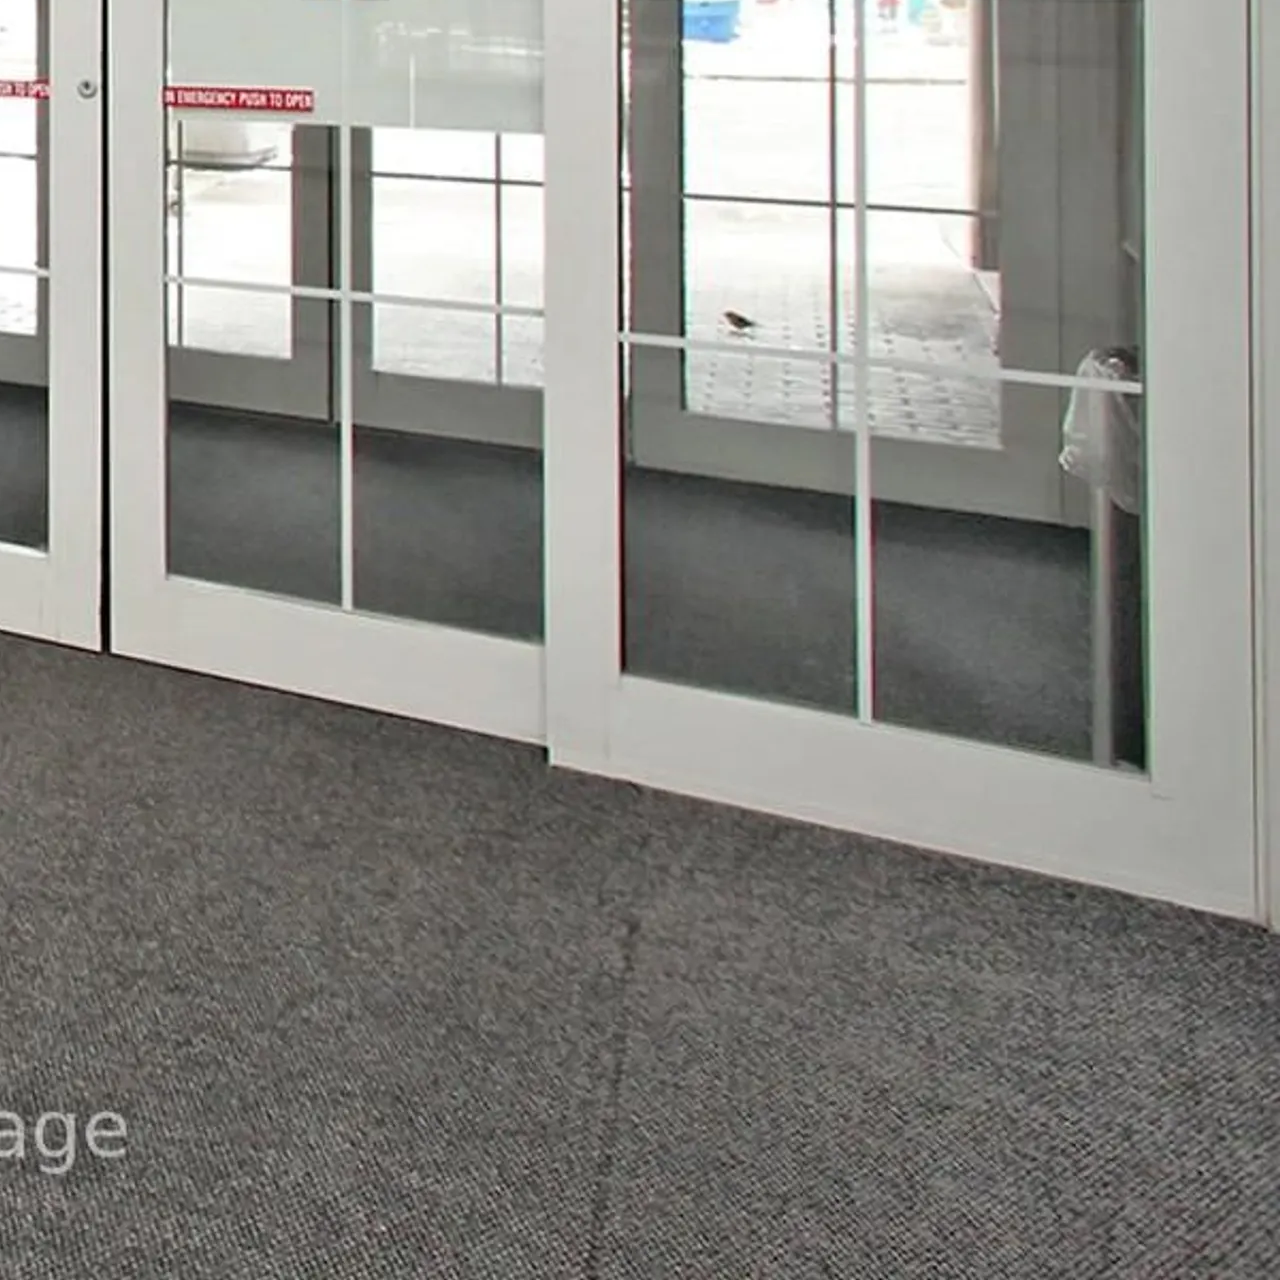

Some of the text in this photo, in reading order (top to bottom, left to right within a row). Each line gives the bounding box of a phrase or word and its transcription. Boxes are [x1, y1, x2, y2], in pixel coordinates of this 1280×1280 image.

[177, 90, 236, 106] EMERGENCY
[239, 92, 267, 107] PUSH
[269, 93, 283, 108] TO
[286, 93, 313, 109] OPEN
